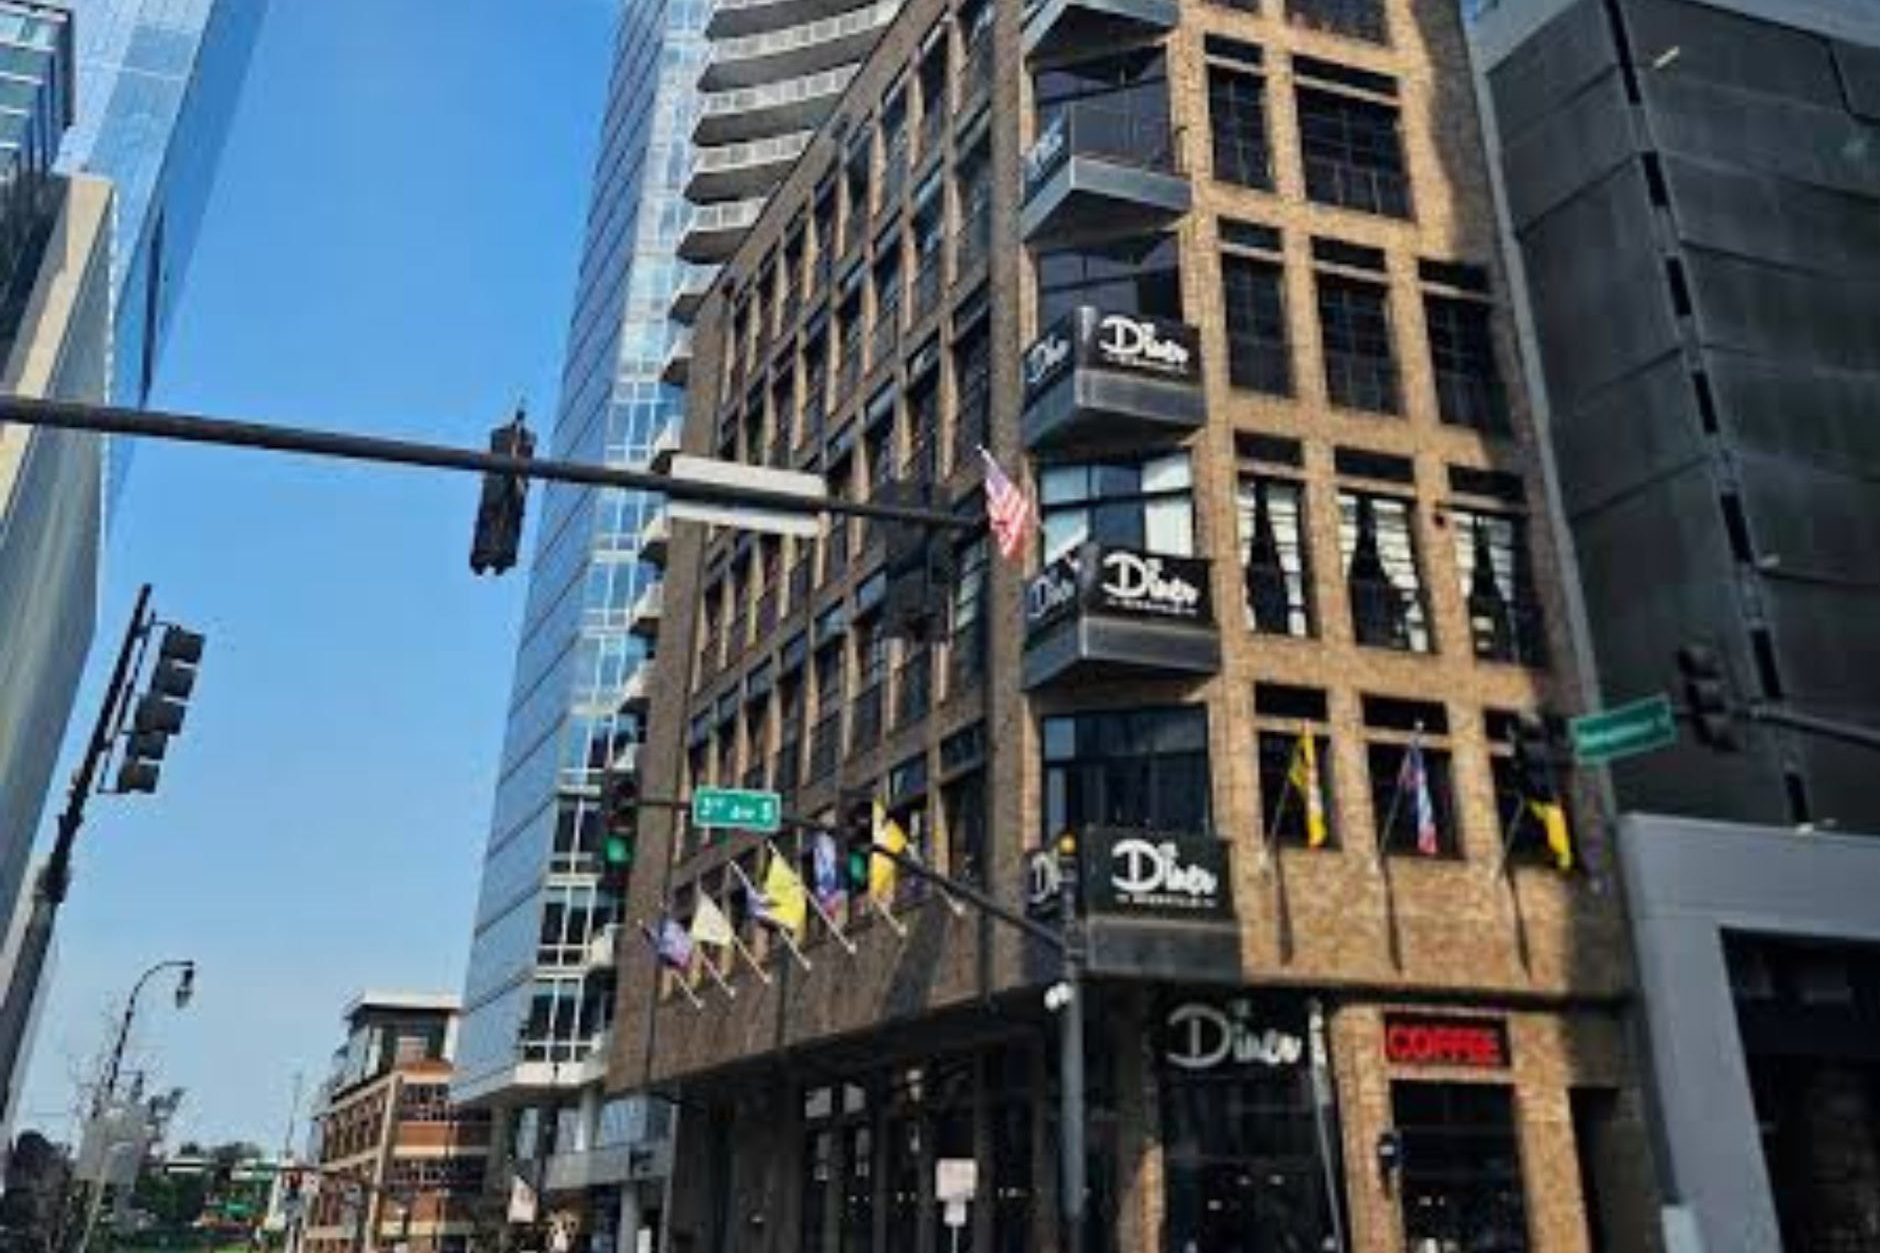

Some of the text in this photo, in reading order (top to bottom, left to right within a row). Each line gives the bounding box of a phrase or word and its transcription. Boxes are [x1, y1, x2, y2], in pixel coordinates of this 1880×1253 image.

[1099, 315, 1189, 363] Diner
[1101, 552, 1199, 605] Diner
[1111, 839, 1218, 895] Diner
[1167, 999, 1301, 1068] Diner
[1388, 1024, 1503, 1065] COFFEE
